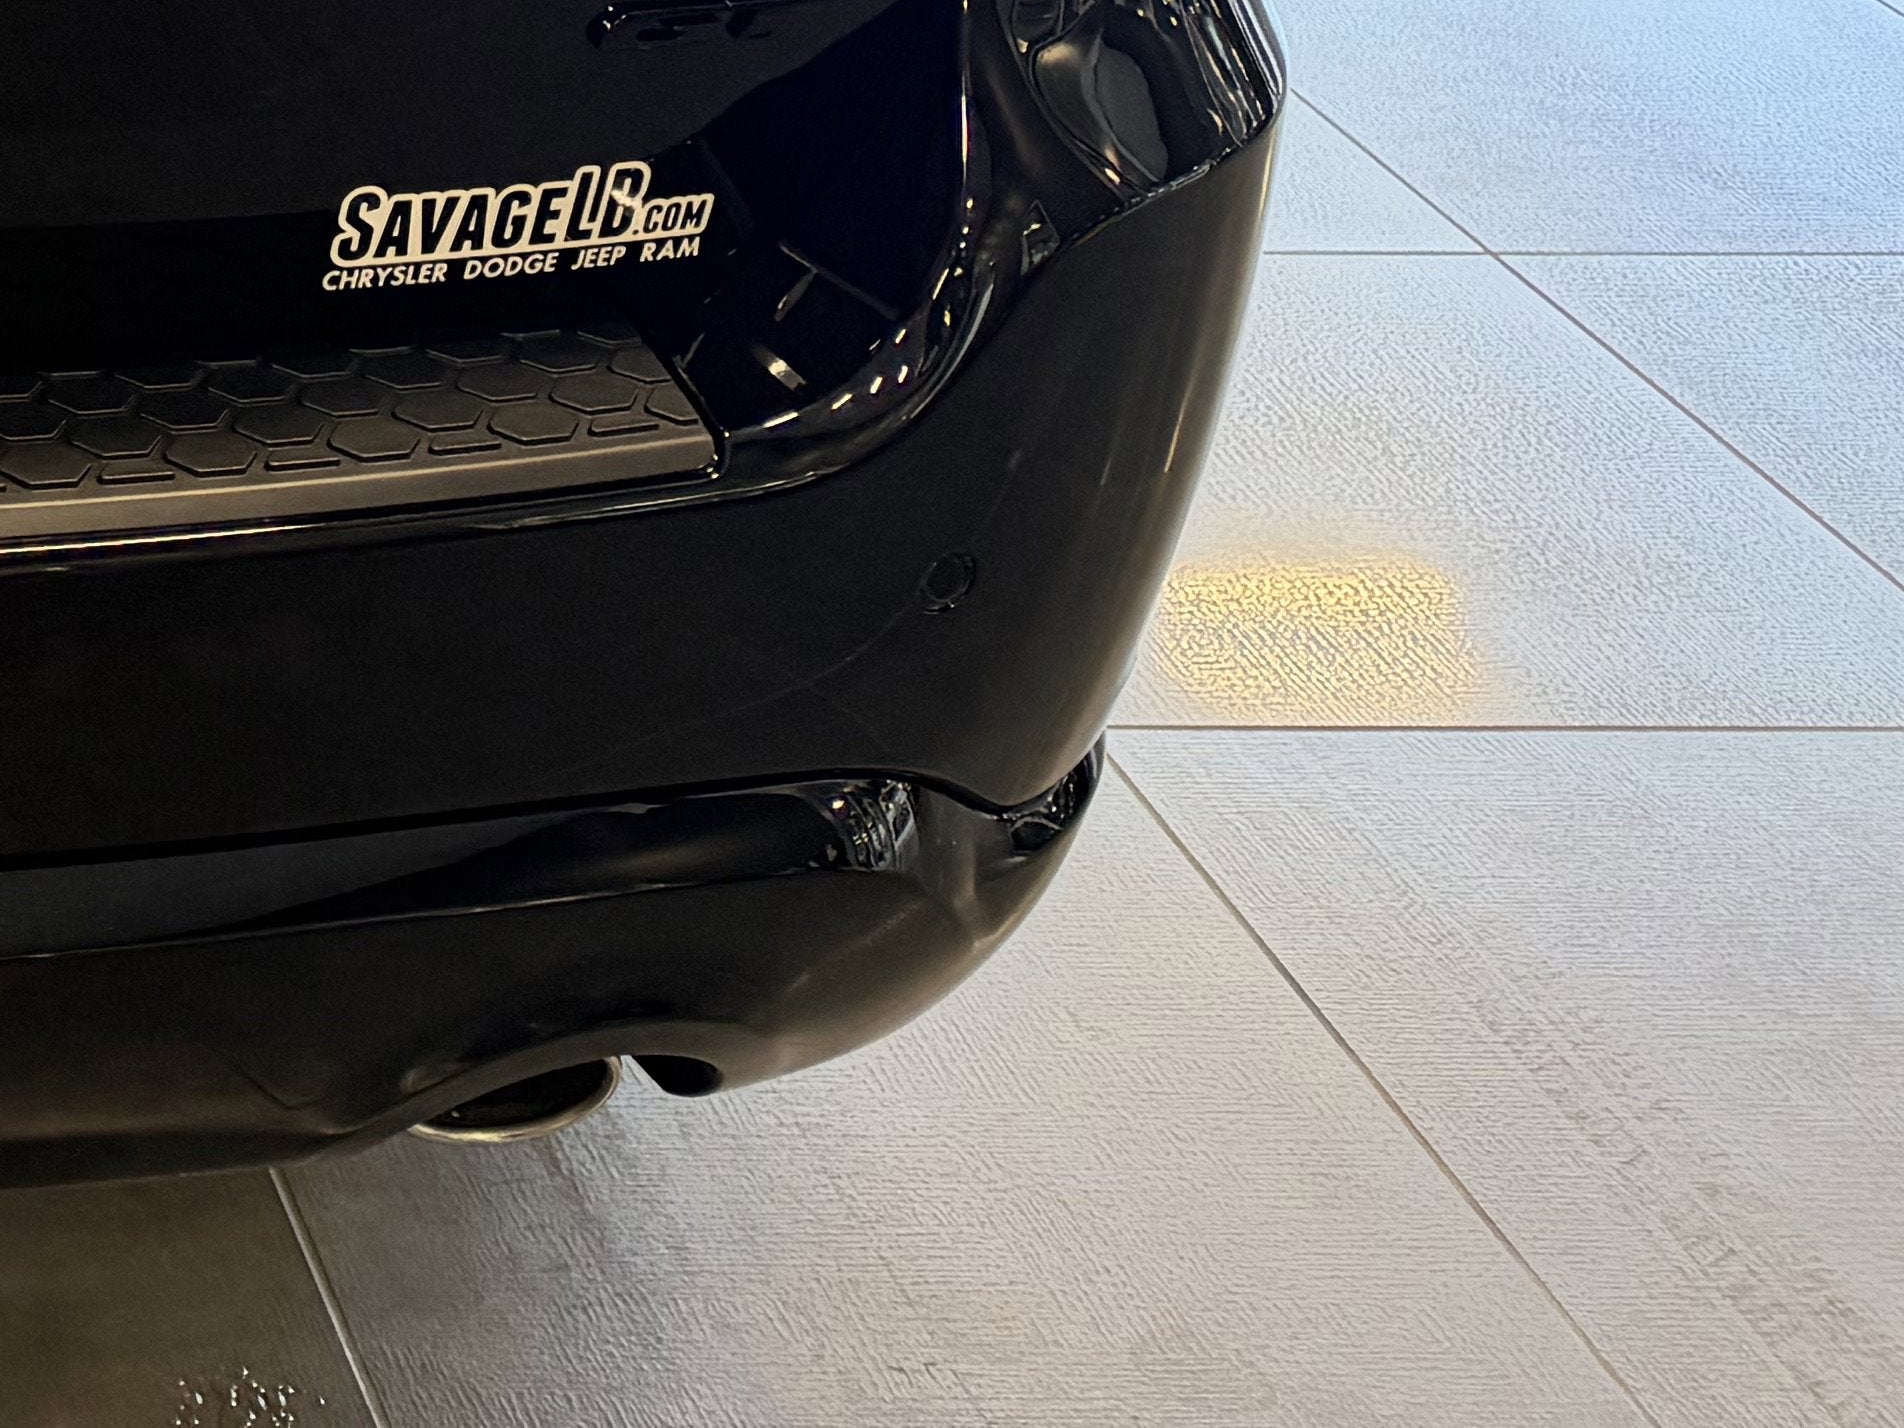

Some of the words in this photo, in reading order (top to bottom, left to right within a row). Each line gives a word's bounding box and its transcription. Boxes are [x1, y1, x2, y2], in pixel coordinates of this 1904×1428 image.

[322, 263, 448, 291] CHRYSLER
[463, 253, 559, 280] DODGE
[571, 245, 627, 271] JEEP
[639, 236, 700, 263] RAM
